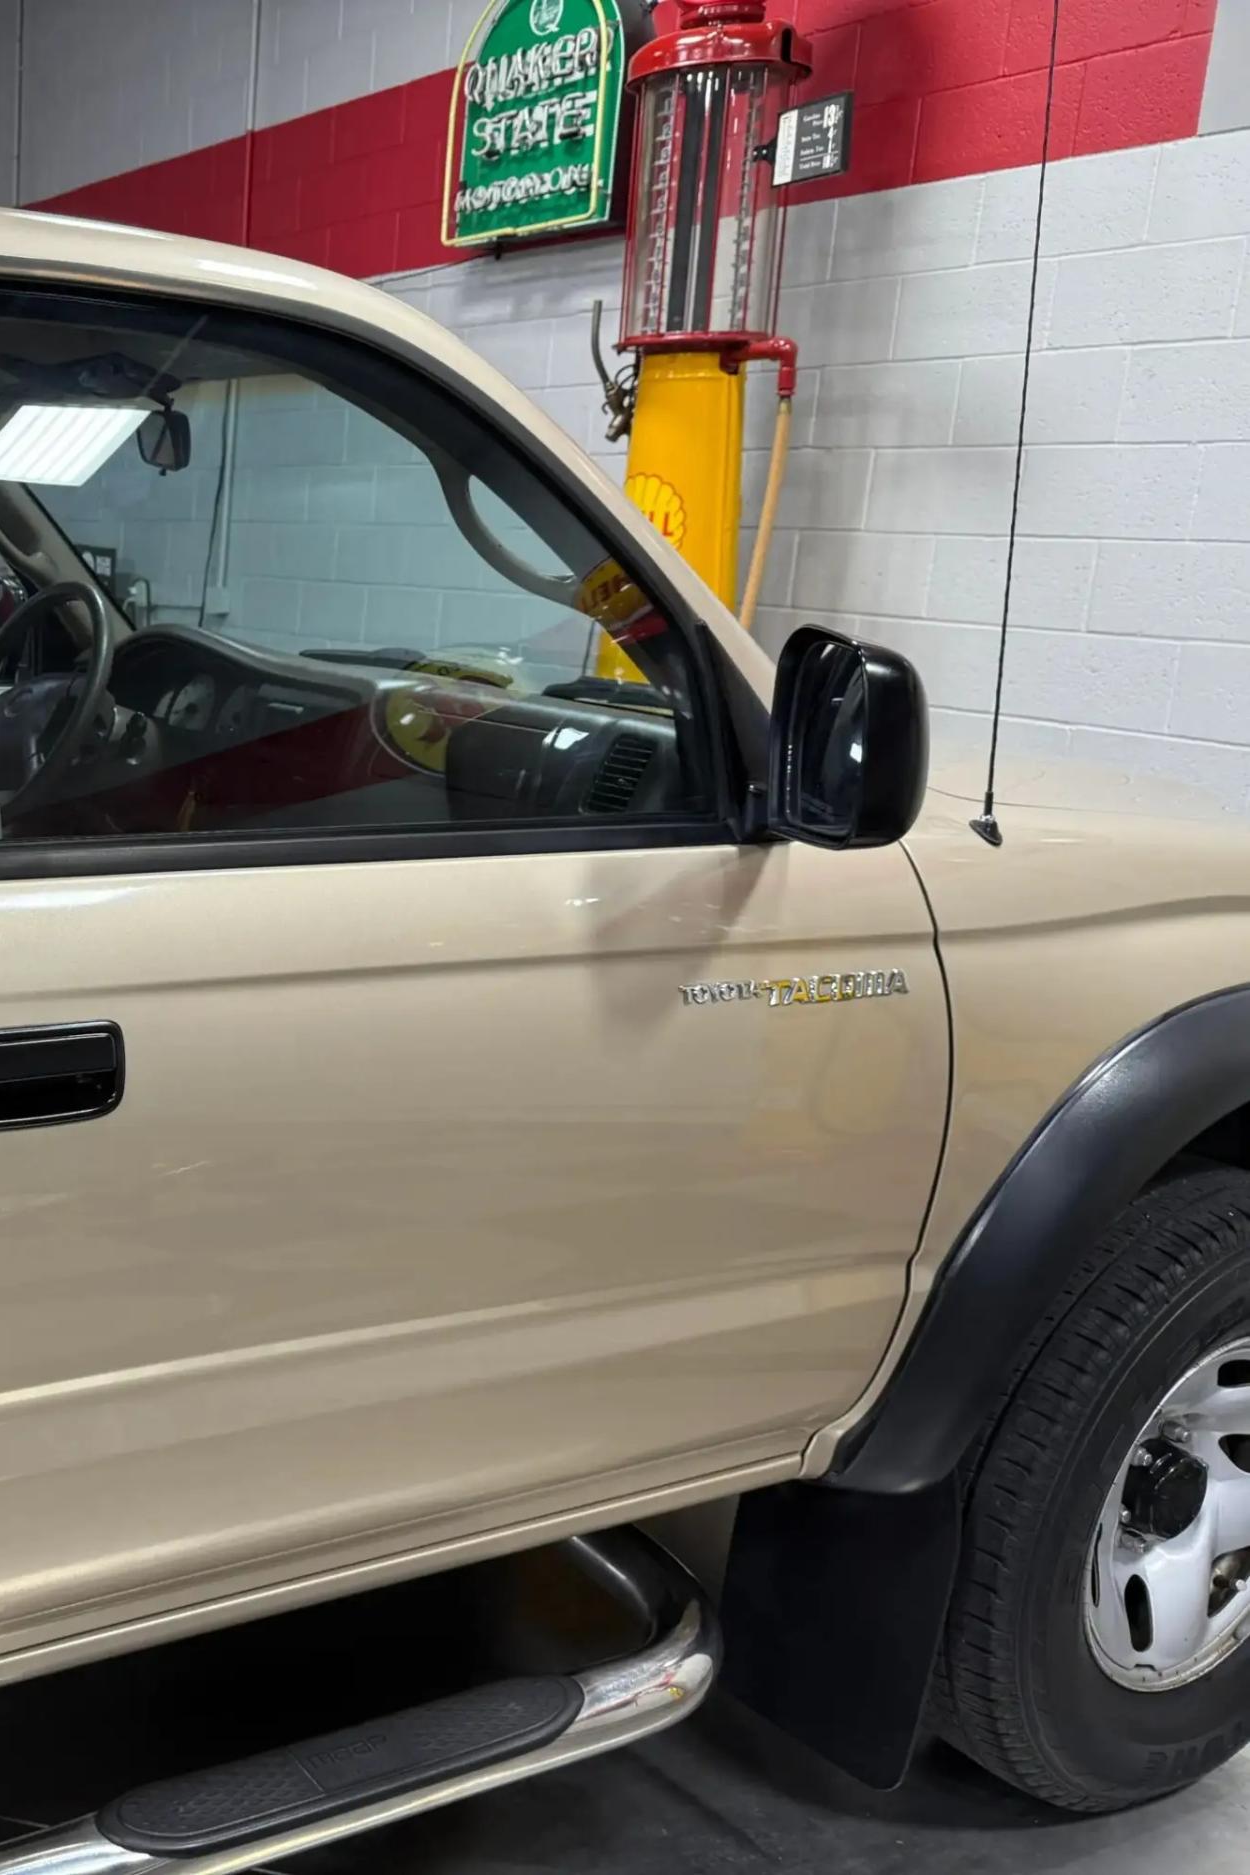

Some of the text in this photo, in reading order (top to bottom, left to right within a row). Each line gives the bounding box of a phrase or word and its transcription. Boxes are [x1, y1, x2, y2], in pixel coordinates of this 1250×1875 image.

[464, 27, 613, 111] QUAKER
[471, 91, 597, 160] STATE
[678, 968, 909, 1006] TOYOTA TACOMA
